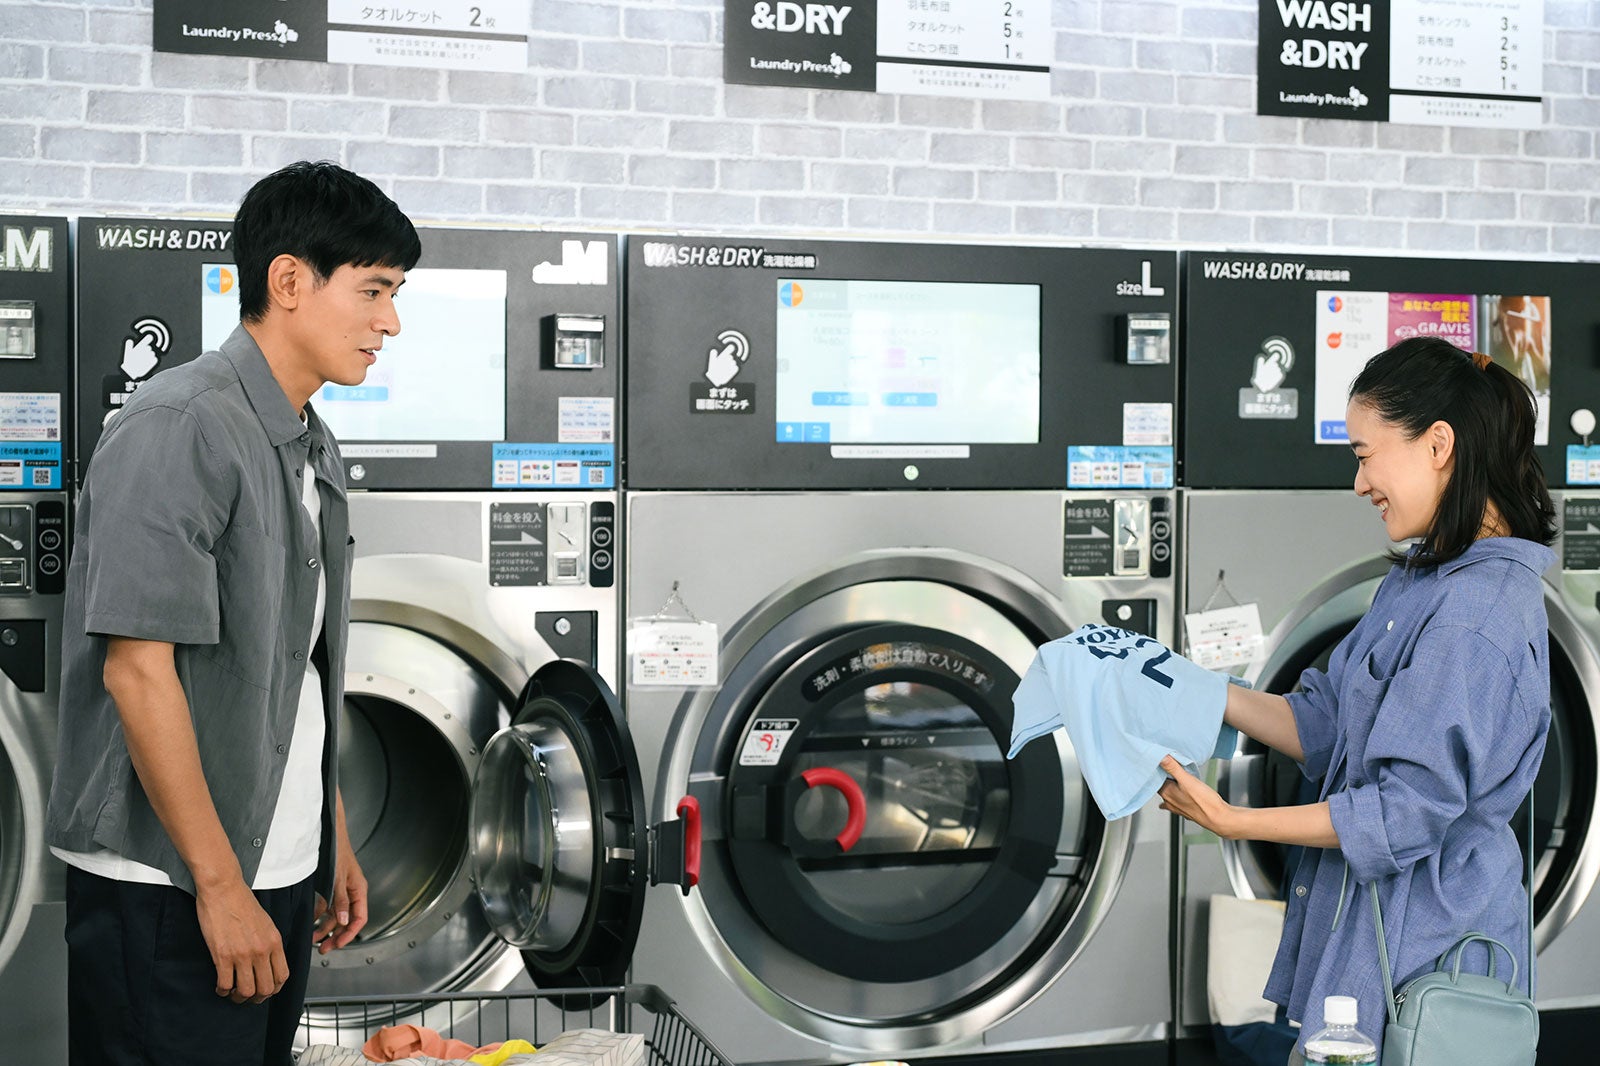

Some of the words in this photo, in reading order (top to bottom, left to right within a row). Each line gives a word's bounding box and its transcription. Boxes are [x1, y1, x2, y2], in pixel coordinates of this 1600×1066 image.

[361, 6, 442, 24] タオルケット
[750, 1, 852, 36] &DRY
[1277, 0, 1371, 32] WASH
[182, 24, 241, 42] Laundry
[1280, 39, 1369, 71] &DRY
[750, 57, 802, 74] Laundry
[1280, 91, 1324, 107] Laundry
[1417, 322, 1472, 336] GRAVIS
[708, 387, 738, 398] まずは
[695, 399, 750, 411] 画面にタッチ
[493, 511, 543, 524] 料金を投入
